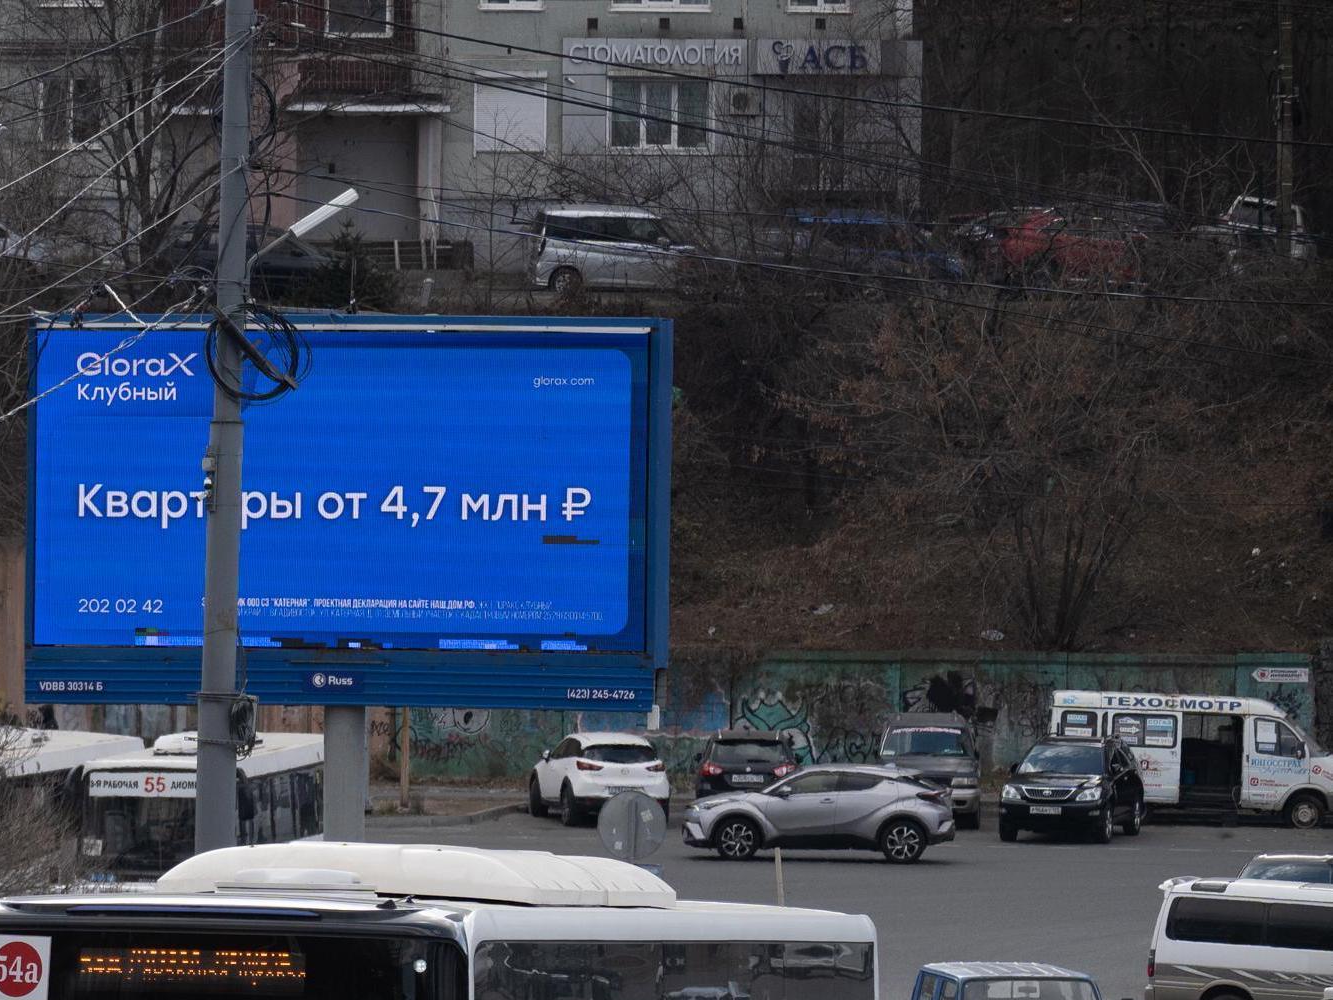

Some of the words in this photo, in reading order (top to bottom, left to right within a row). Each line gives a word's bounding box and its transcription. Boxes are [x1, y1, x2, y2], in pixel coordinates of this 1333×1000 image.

[569, 44, 742, 66] СТОМАТОЛОГИЯ
[800, 44, 867, 69] АСБ
[76, 351, 198, 376] GloraX
[533, 375, 595, 389] glorax.com
[77, 381, 177, 406] Клубный
[77, 484, 303, 528] Квартры
[318, 490, 367, 519] от
[380, 485, 447, 528] 4,7
[461, 491, 547, 521] млн
[561, 487, 592, 522] ₽
[78, 598, 110, 613] 202
[115, 598, 137, 614] 02
[142, 599, 163, 614] 42
[313, 598, 351, 608] ПРОЕКТНАЯ
[353, 599, 397, 609] ДЕКЛАРАЦИЯ
[398, 599, 408, 609] НА
[409, 597, 429, 609] САЙТЕ
[39, 681, 66, 691] VDBB
[67, 681, 94, 692] 30314
[328, 675, 353, 686] Russ
[567, 688, 590, 700] (423)
[592, 688, 635, 700] 245-4726
[1103, 696, 1243, 711] ТЕХОСМОТР
[103, 780, 139, 790] РАБОЧАЯ
[144, 776, 166, 793] 55
[170, 780, 197, 790] ДИОМ
